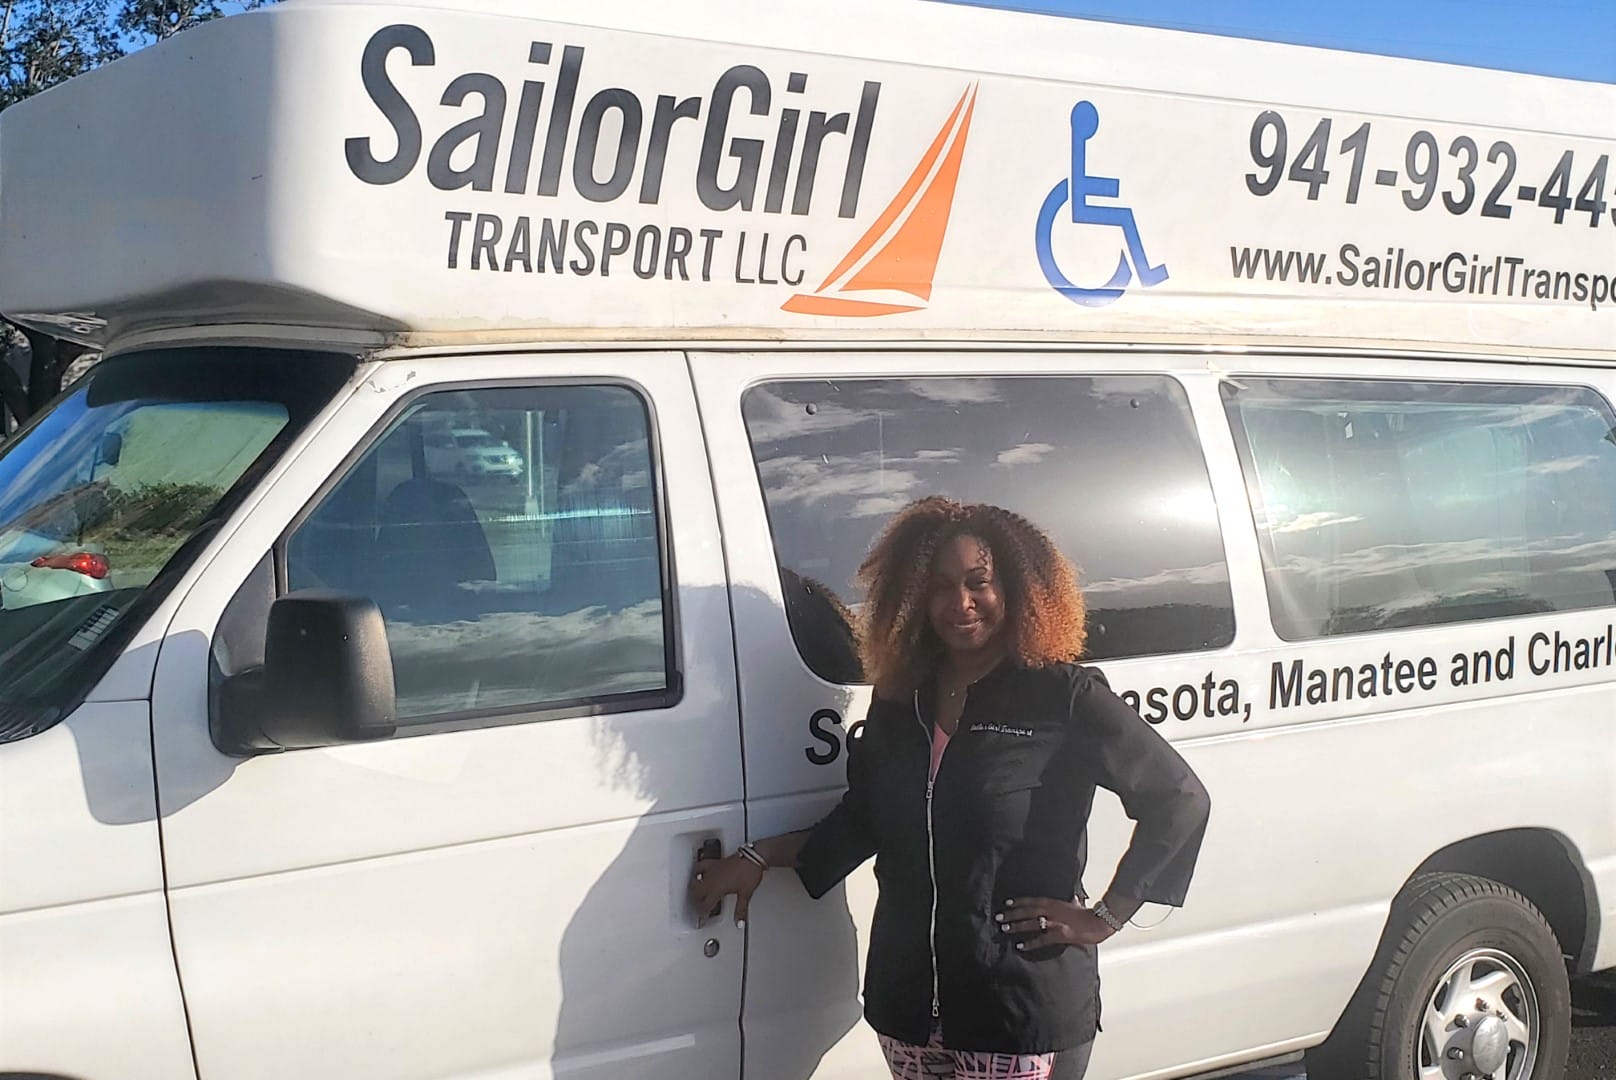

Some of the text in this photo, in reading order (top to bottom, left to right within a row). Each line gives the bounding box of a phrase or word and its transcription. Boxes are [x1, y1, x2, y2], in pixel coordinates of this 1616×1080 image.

[345, 24, 881, 218] SailorGirl
[1246, 110, 1616, 229] 941-932-44
[445, 211, 807, 285] TRANSPORT LLC
[1270, 651, 1437, 709] Manatee
[1451, 636, 1515, 687] and
[1528, 624, 1616, 676] Charl
